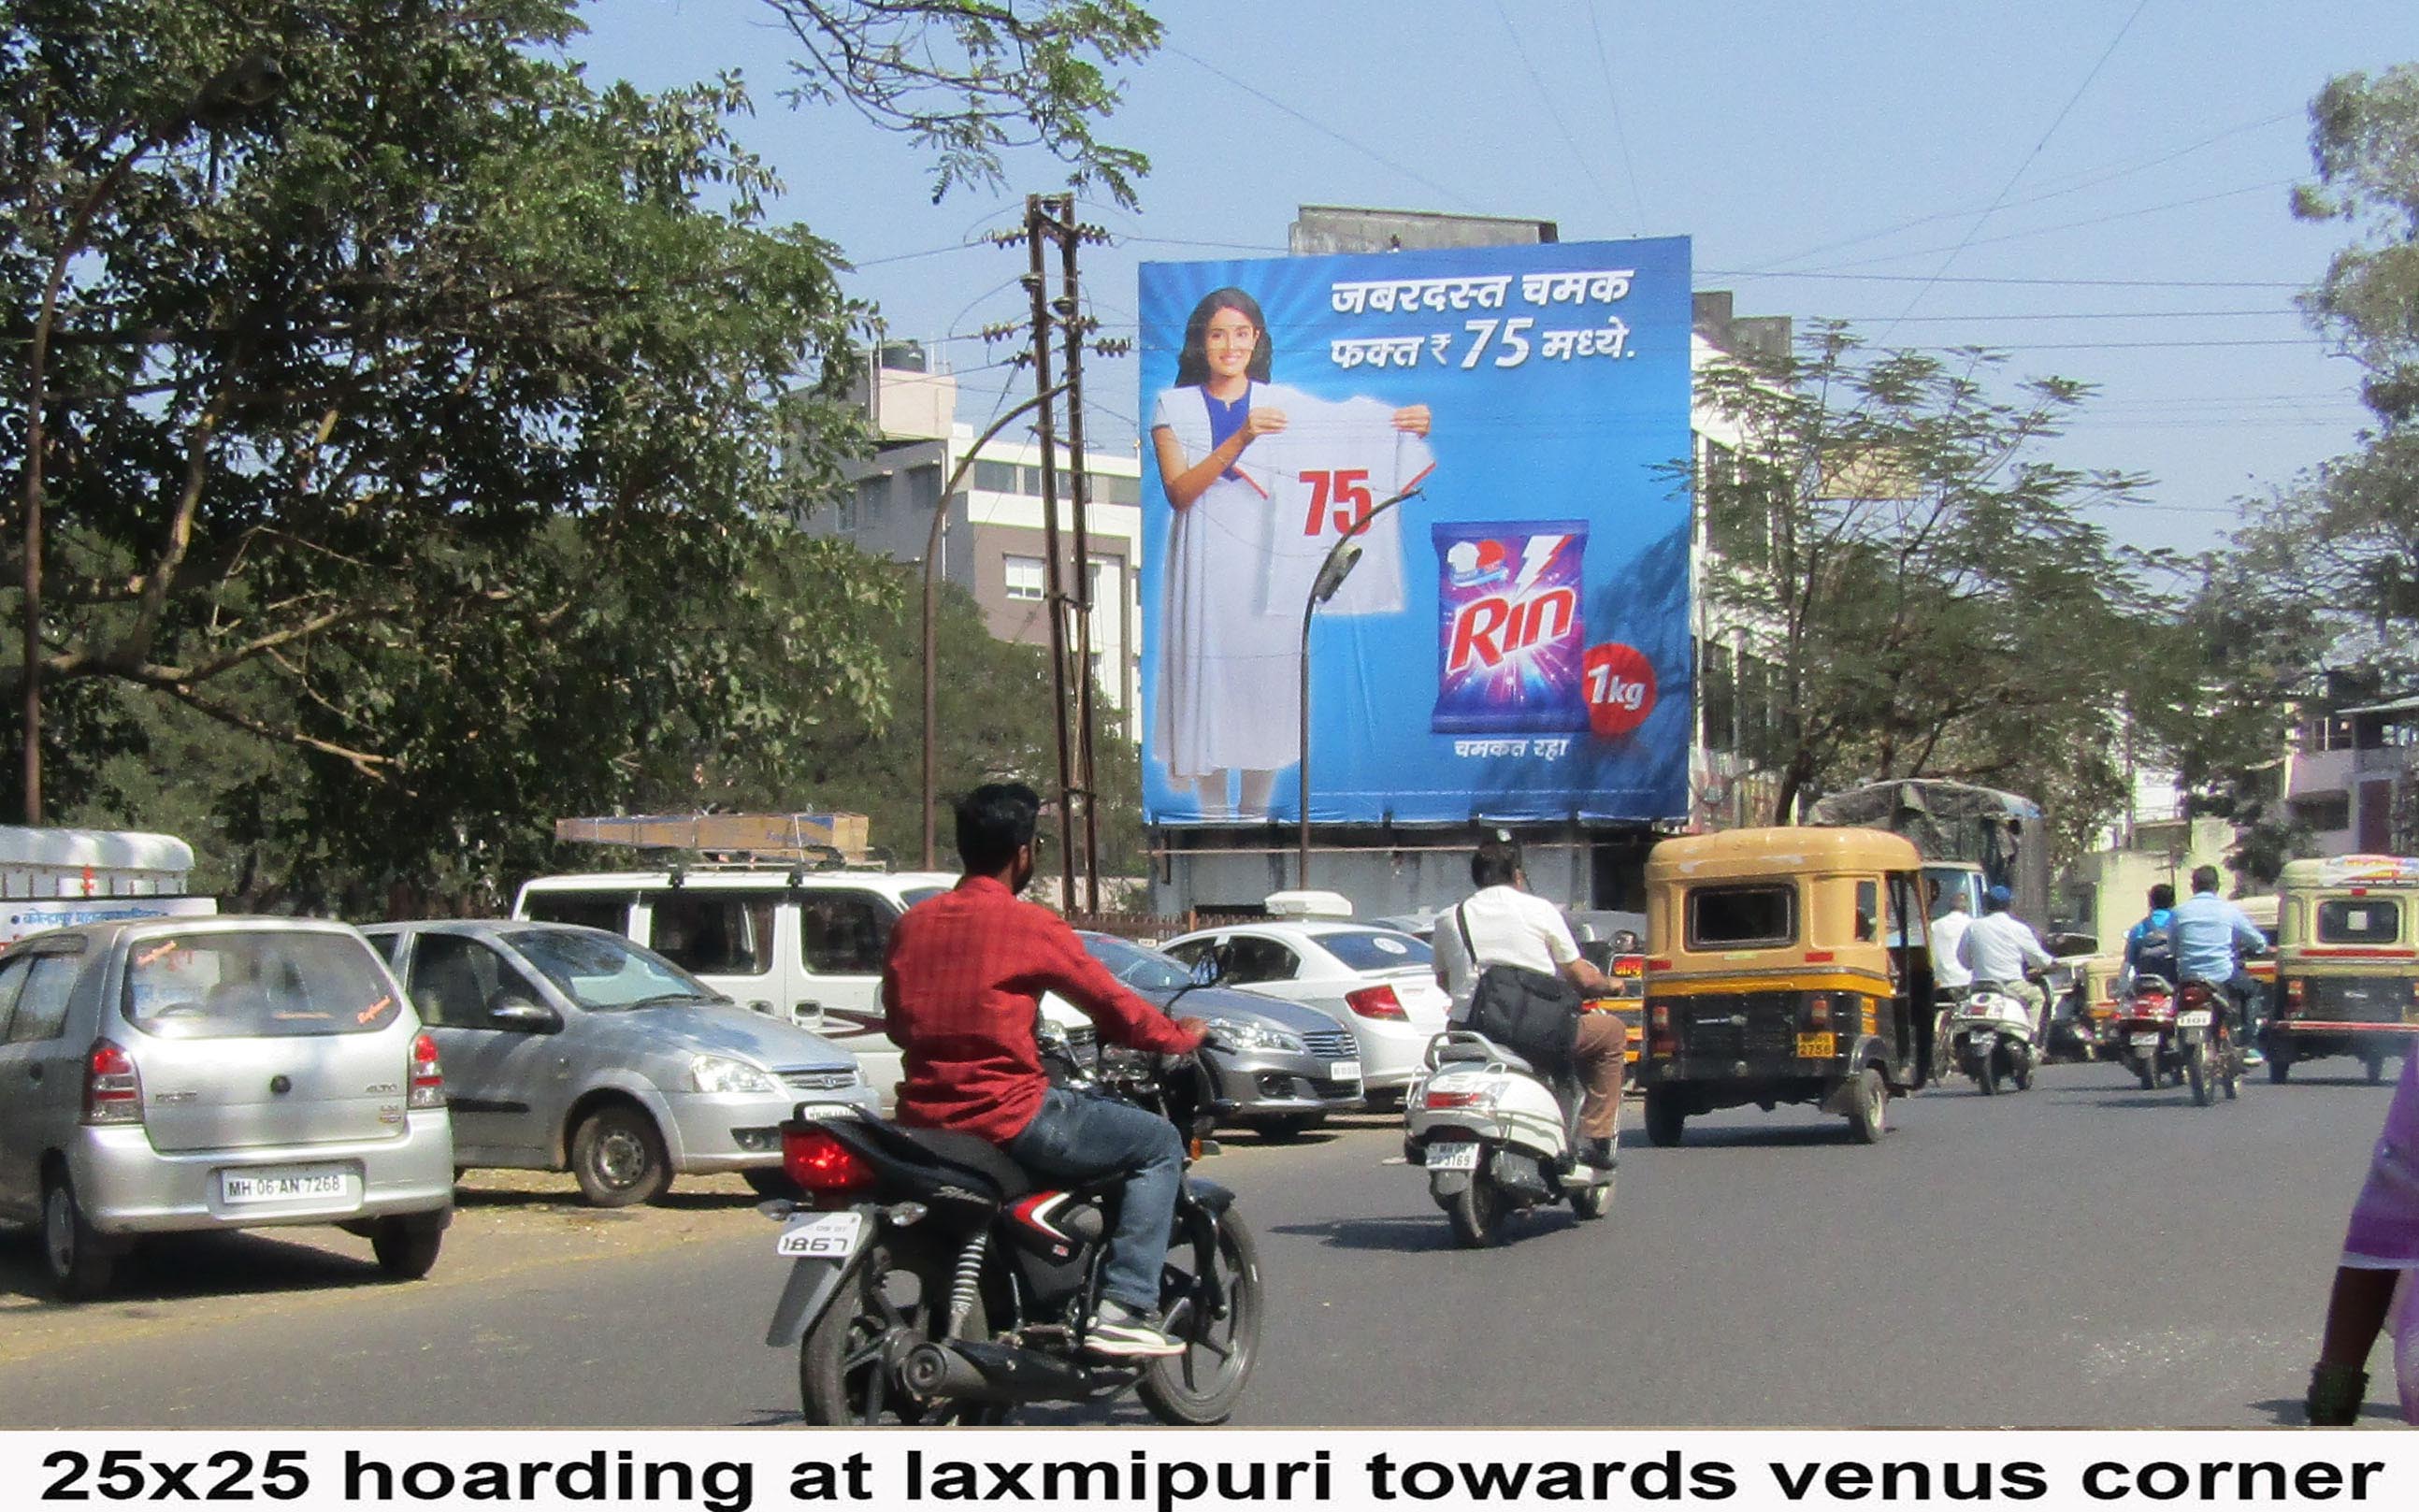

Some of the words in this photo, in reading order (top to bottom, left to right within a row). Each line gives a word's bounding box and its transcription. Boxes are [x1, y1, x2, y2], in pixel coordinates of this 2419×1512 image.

[1332, 276, 1513, 314] जबरदस्त
[1521, 269, 1634, 306] चमक
[1331, 336, 1425, 368] फक्त
[1461, 317, 1534, 368] 75
[1542, 315, 1635, 361] मध्ये.
[1299, 468, 1372, 537] 75
[1446, 586, 1577, 674] Rin
[1588, 664, 1646, 712] 1kg
[1454, 739, 1529, 758] चमकत
[1533, 738, 1570, 761] रहा
[228, 1181, 252, 1196] MH
[256, 1179, 275, 1195] 06
[280, 1177, 300, 1194] AN
[305, 1174, 340, 1192] 7268
[783, 1237, 849, 1252] 1867
